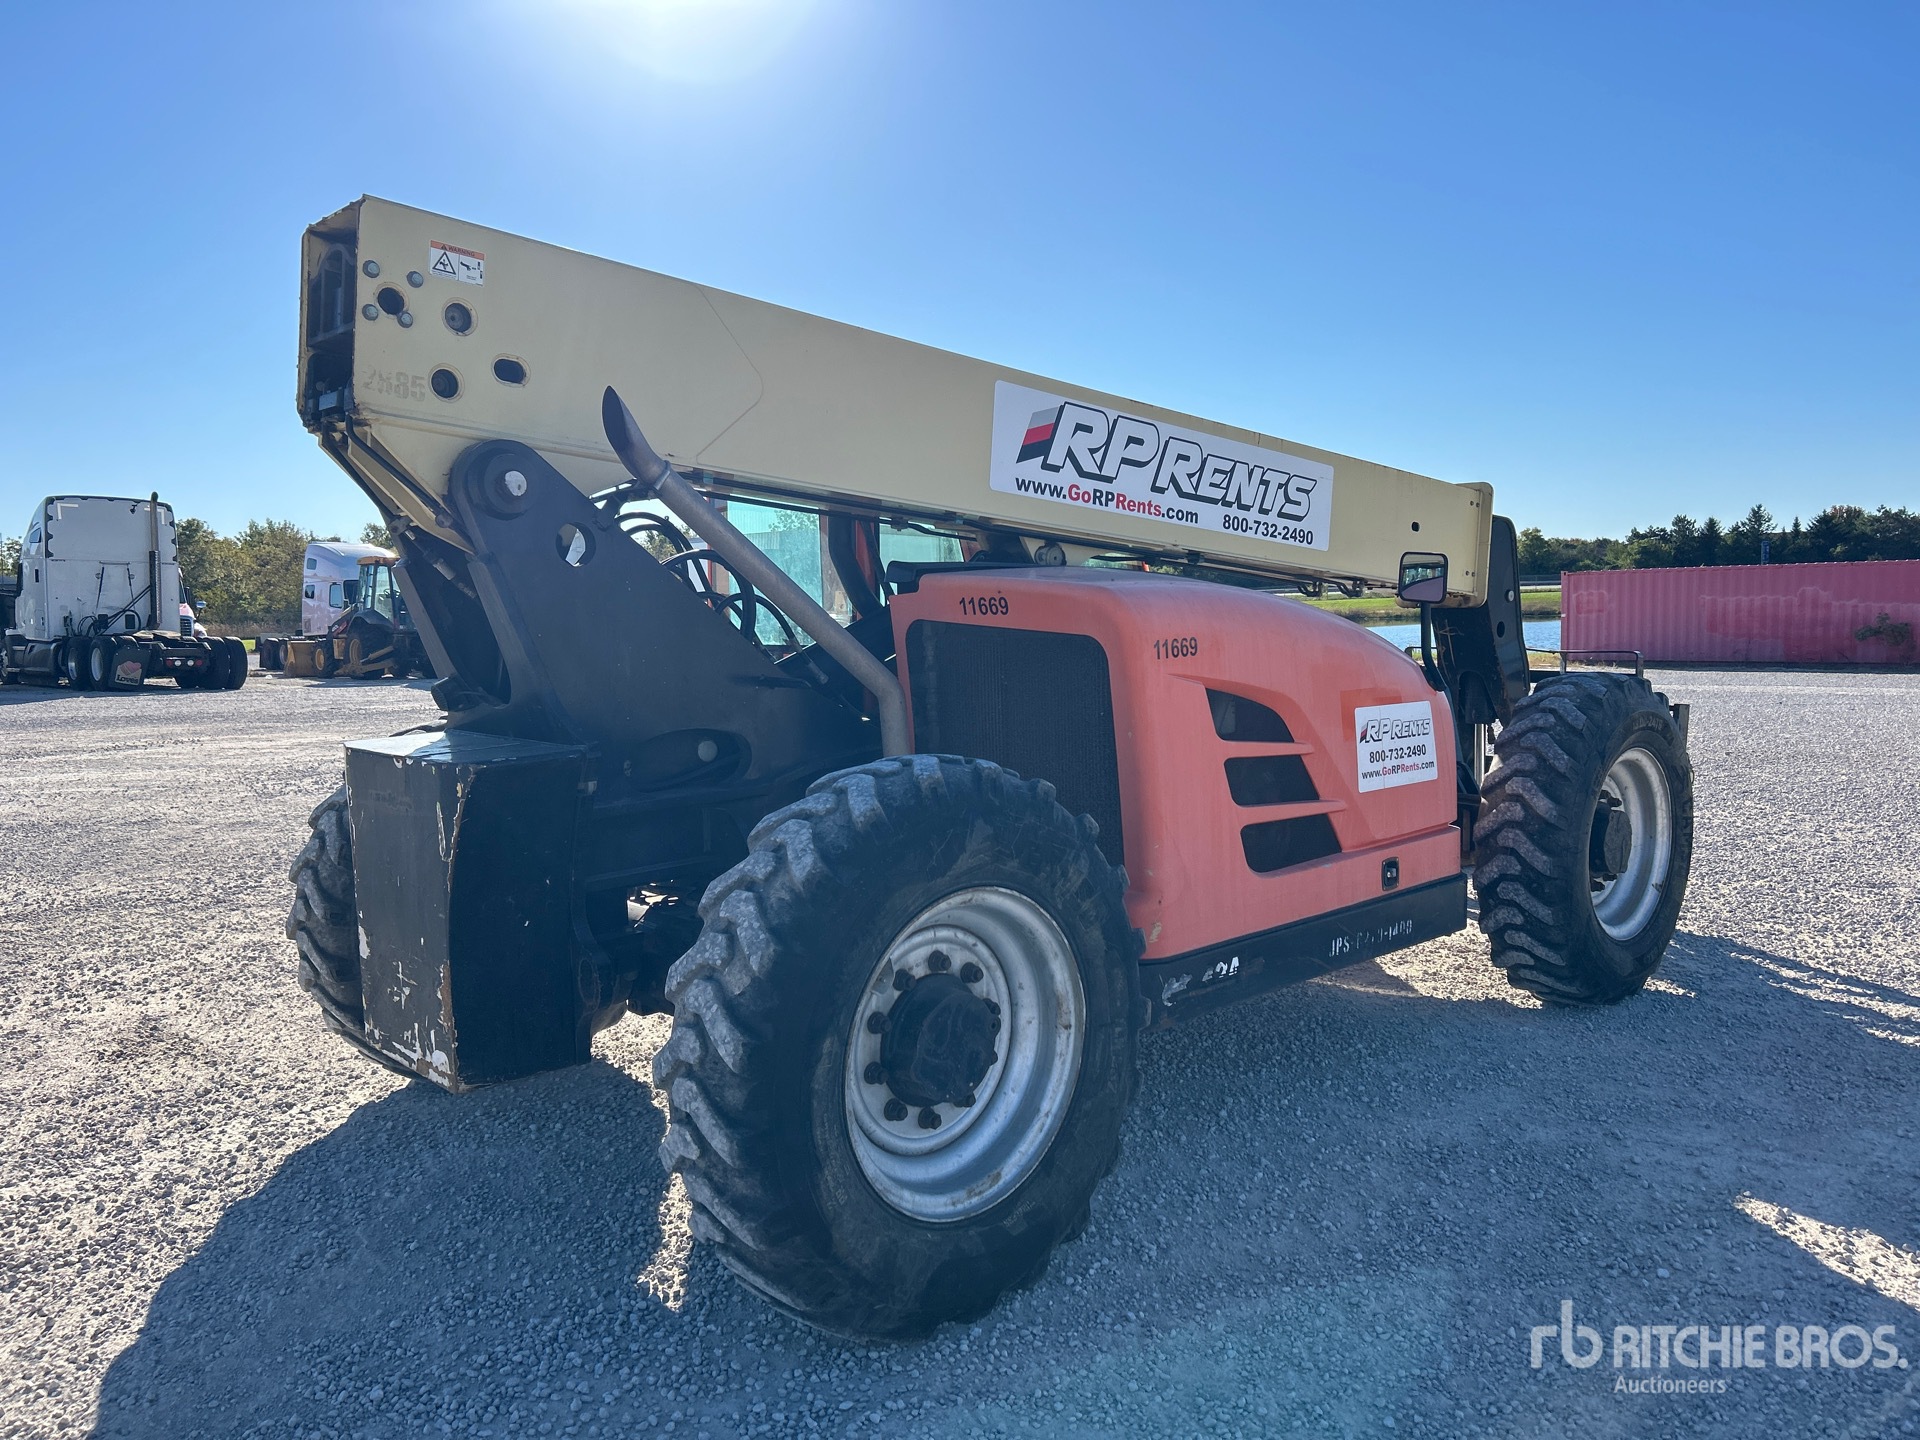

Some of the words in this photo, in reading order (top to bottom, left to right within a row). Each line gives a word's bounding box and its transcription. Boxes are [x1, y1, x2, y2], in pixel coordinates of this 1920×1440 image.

[448, 245, 476, 257] WARNING
[1015, 476, 1199, 524] www.GoRPRents.com
[1222, 513, 1314, 546] 800-732-2490
[958, 596, 1009, 616] 11669
[1153, 636, 1198, 660] 11669
[1369, 744, 1427, 763] 800-732-2490
[1361, 760, 1435, 779] www.GoRPRents.com
